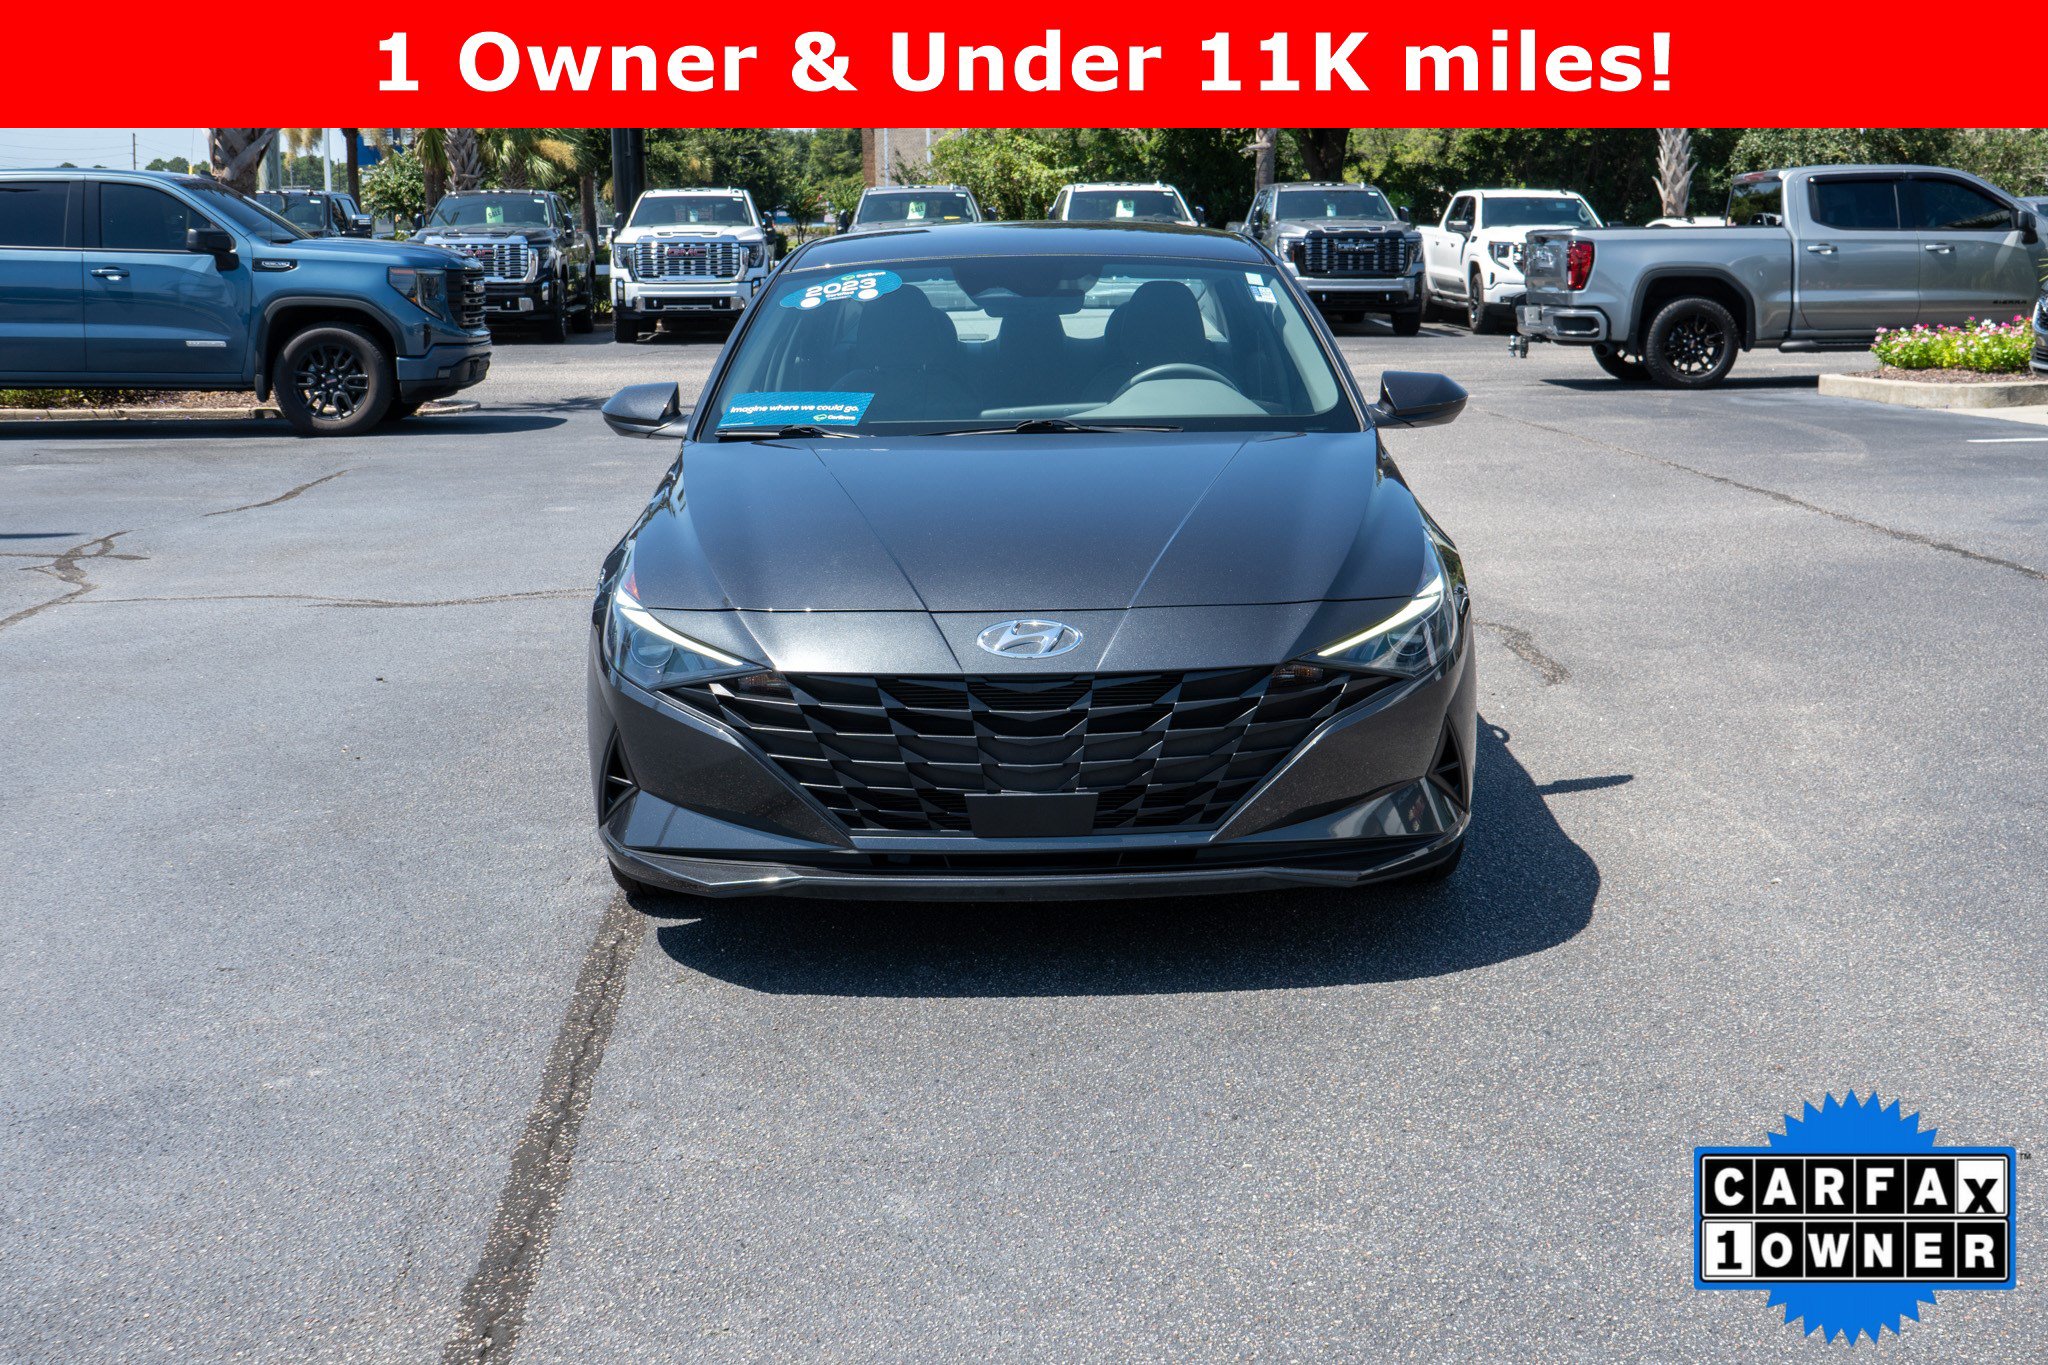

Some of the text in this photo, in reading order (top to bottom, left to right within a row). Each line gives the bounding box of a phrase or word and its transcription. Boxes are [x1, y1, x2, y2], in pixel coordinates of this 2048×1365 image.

[805, 277, 877, 298] 2023
[730, 404, 769, 414] Imagine
[769, 404, 800, 412] where
[816, 403, 844, 411] could
[843, 404, 859, 413] go.
